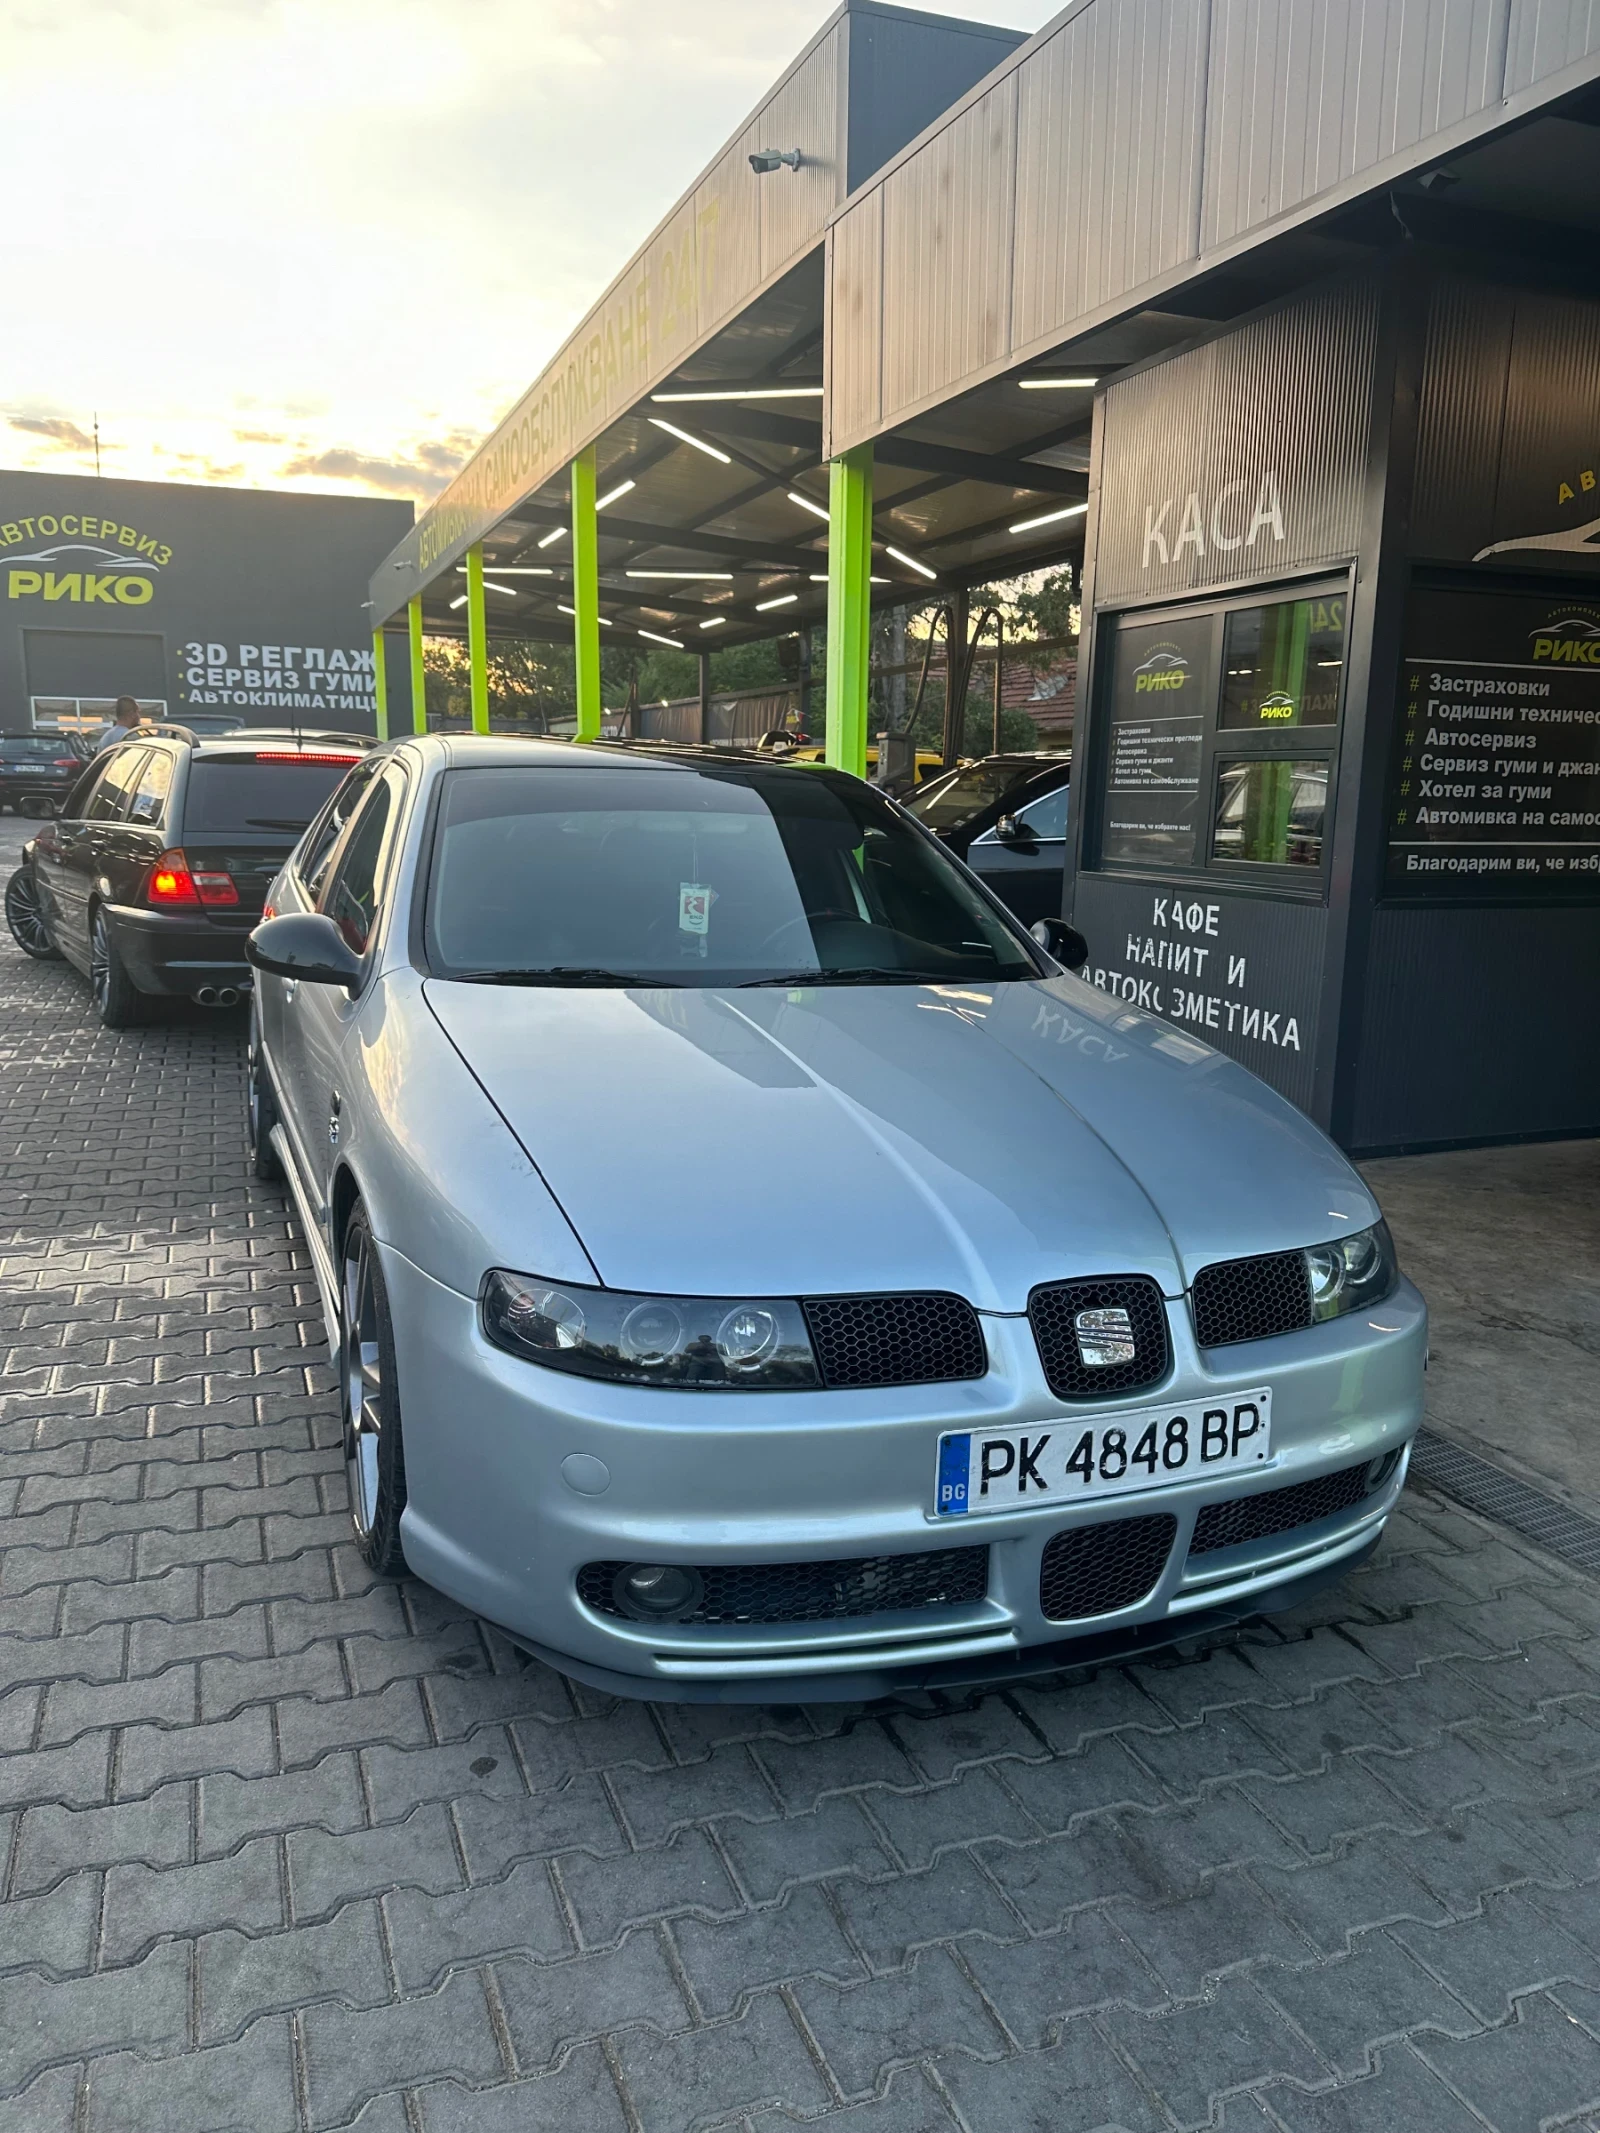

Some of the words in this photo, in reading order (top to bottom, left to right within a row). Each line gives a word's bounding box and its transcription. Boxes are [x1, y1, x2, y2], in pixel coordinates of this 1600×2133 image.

[1142, 470, 1285, 568] КАСА
[9, 570, 154, 605] РИКО
[185, 642, 228, 666] 3D
[240, 645, 376, 671] РЕГЛАЖ
[187, 668, 300, 689] СЕРВИЗ
[1136, 670, 1185, 693] РИКО
[1429, 673, 1550, 697] Застраховки
[1260, 707, 1292, 719] РИКО
[1427, 700, 1514, 722] Годишни
[1424, 727, 1537, 751] Автосервиз
[1420, 754, 1489, 775] Сервиз
[1494, 760, 1537, 777] гуми
[1542, 761, 1554, 774] и
[1418, 780, 1475, 797] Хотел
[1481, 785, 1503, 798] за
[1509, 786, 1552, 803] гуми
[1416, 807, 1517, 825] Автомивка
[1522, 812, 1544, 825] на
[1406, 855, 1511, 874] Благодарим
[1516, 858, 1540, 873] ви,
[1546, 858, 1565, 870] че
[1569, 855, 1600, 873] изб
[1153, 898, 1220, 936] КАФЕ
[980, 1434, 1051, 1496] PK
[1066, 1416, 1189, 1484] 4848
[1200, 1402, 1260, 1464] BP
[942, 1484, 966, 1502] BG
